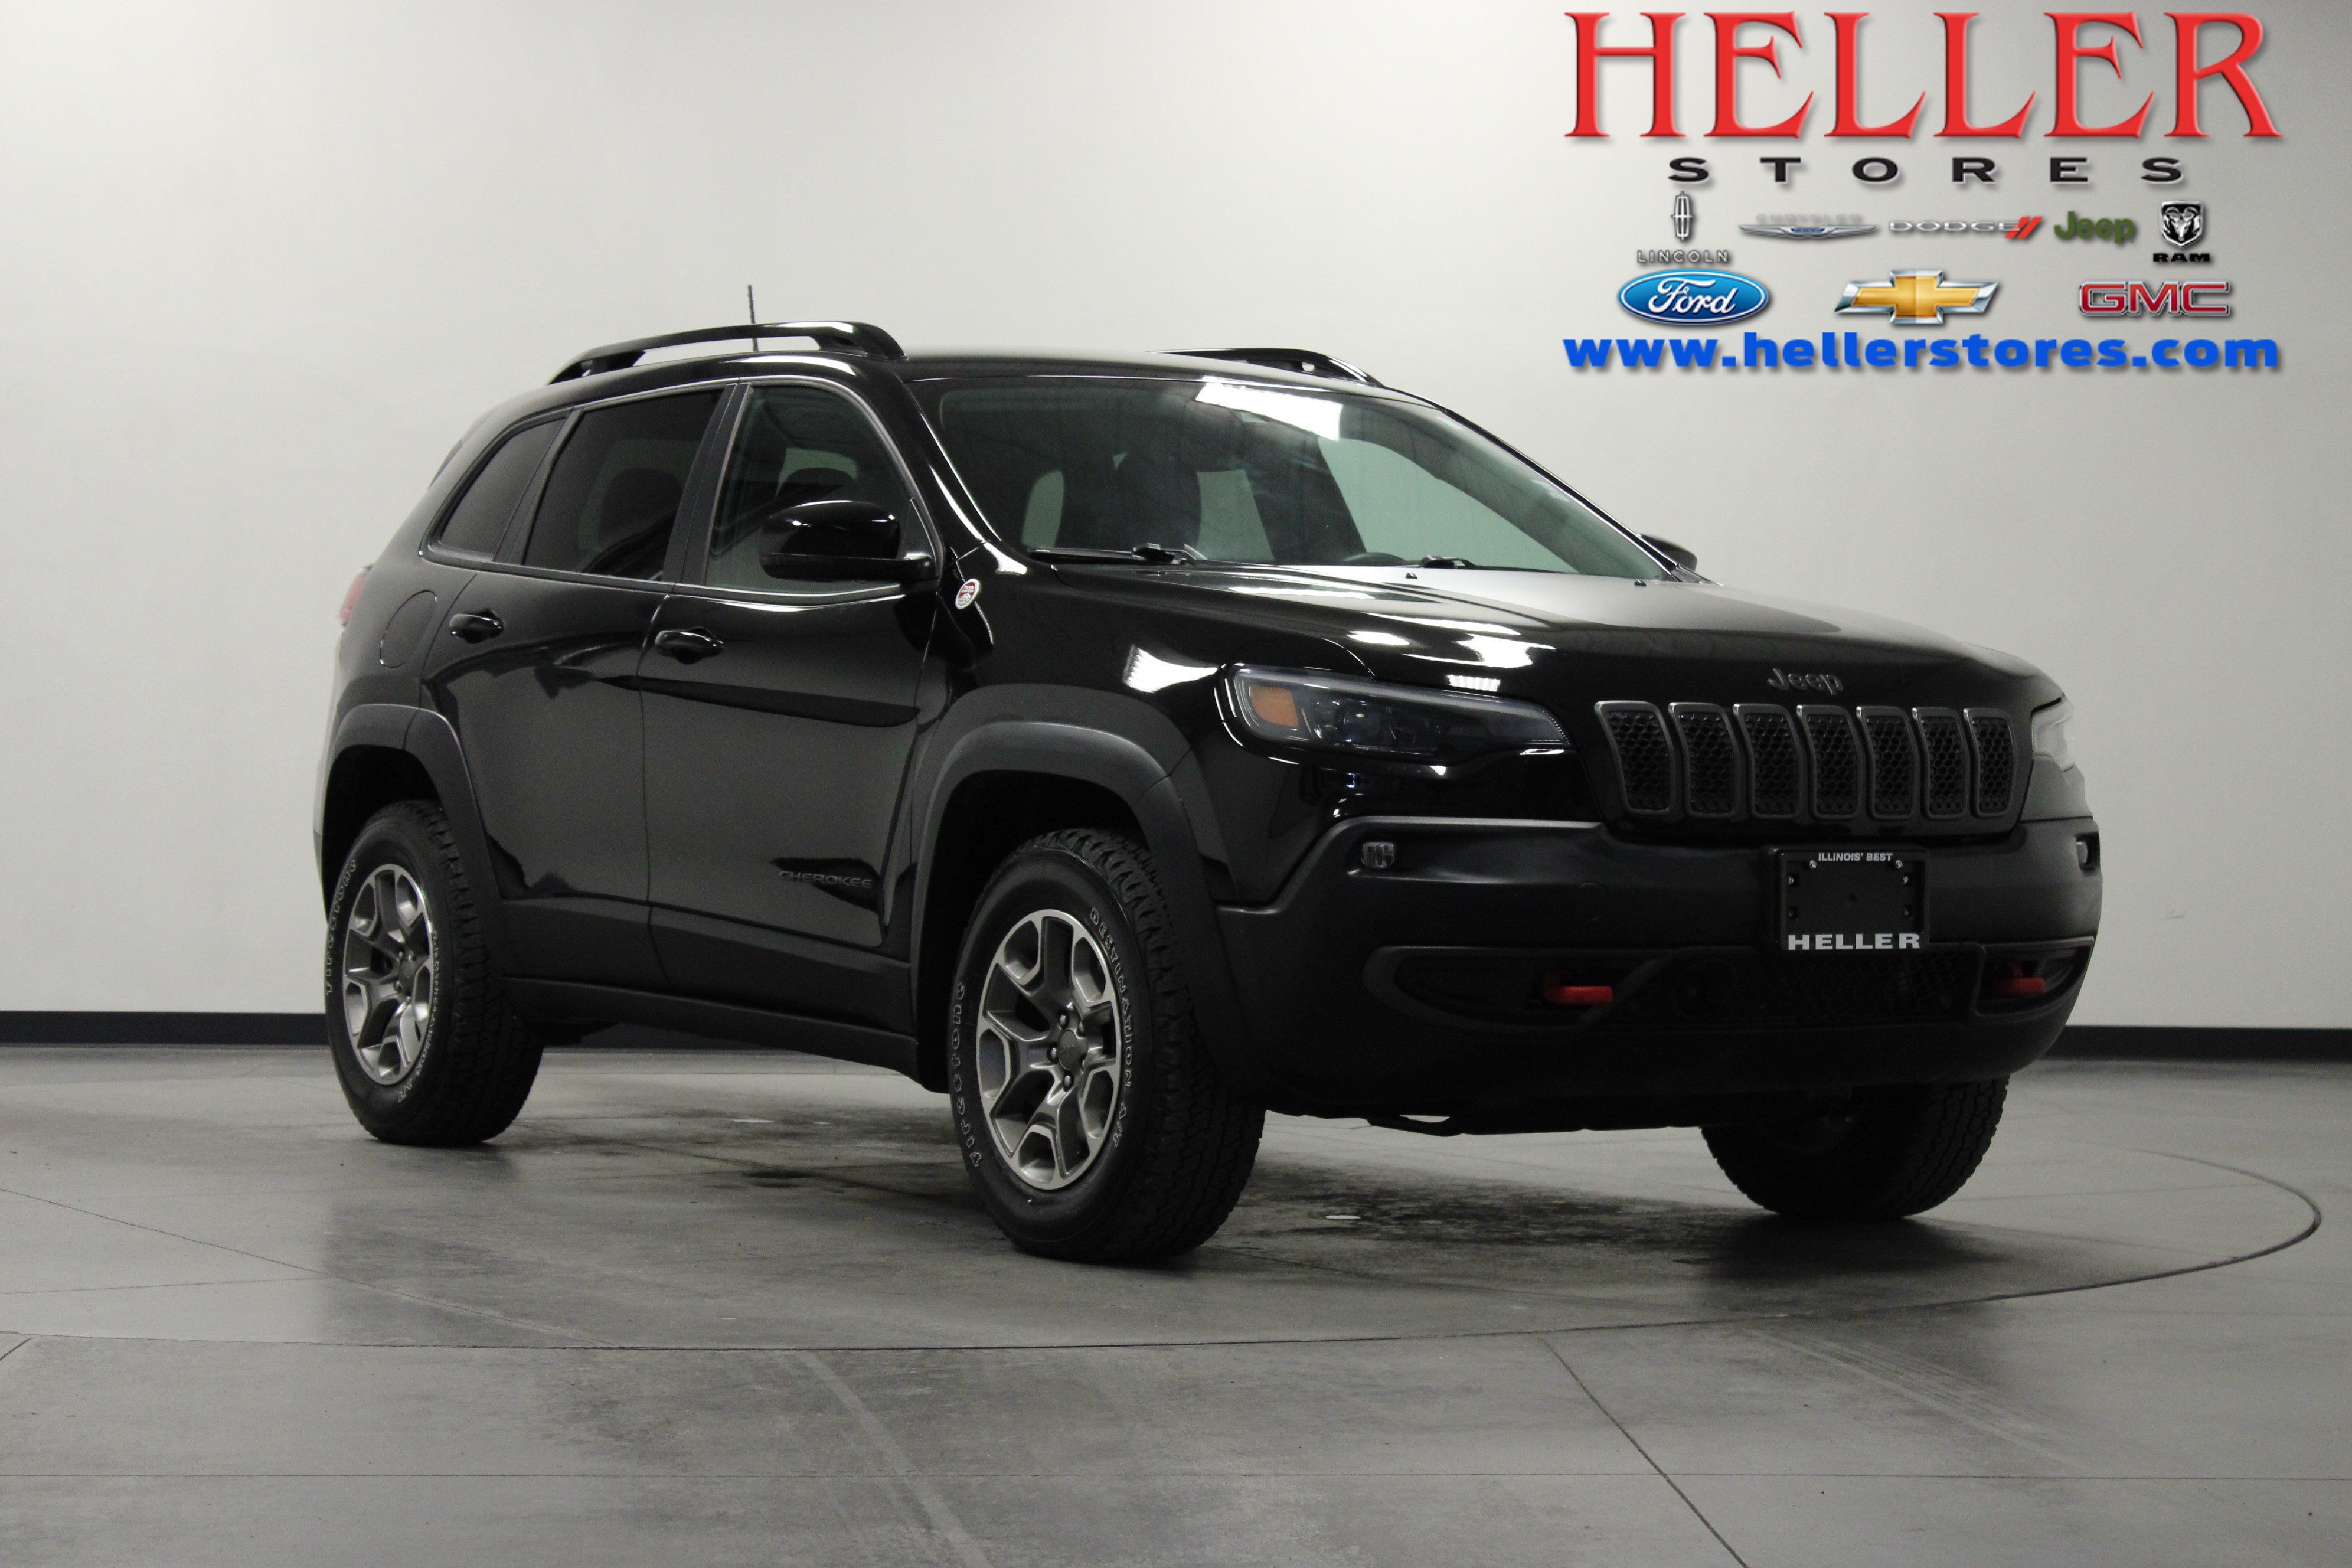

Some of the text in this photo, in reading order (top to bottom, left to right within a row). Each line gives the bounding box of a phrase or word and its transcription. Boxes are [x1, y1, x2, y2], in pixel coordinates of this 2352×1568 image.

[1768, 668, 1843, 695] Jeep
[1818, 853, 1893, 861] ILLINOIS' BEST
[779, 870, 873, 888] CHEROKEE
[1788, 933, 1920, 950] HELLER
[1090, 906, 1132, 1148] DESTINATION A/T
[951, 982, 982, 1167] Firestone
